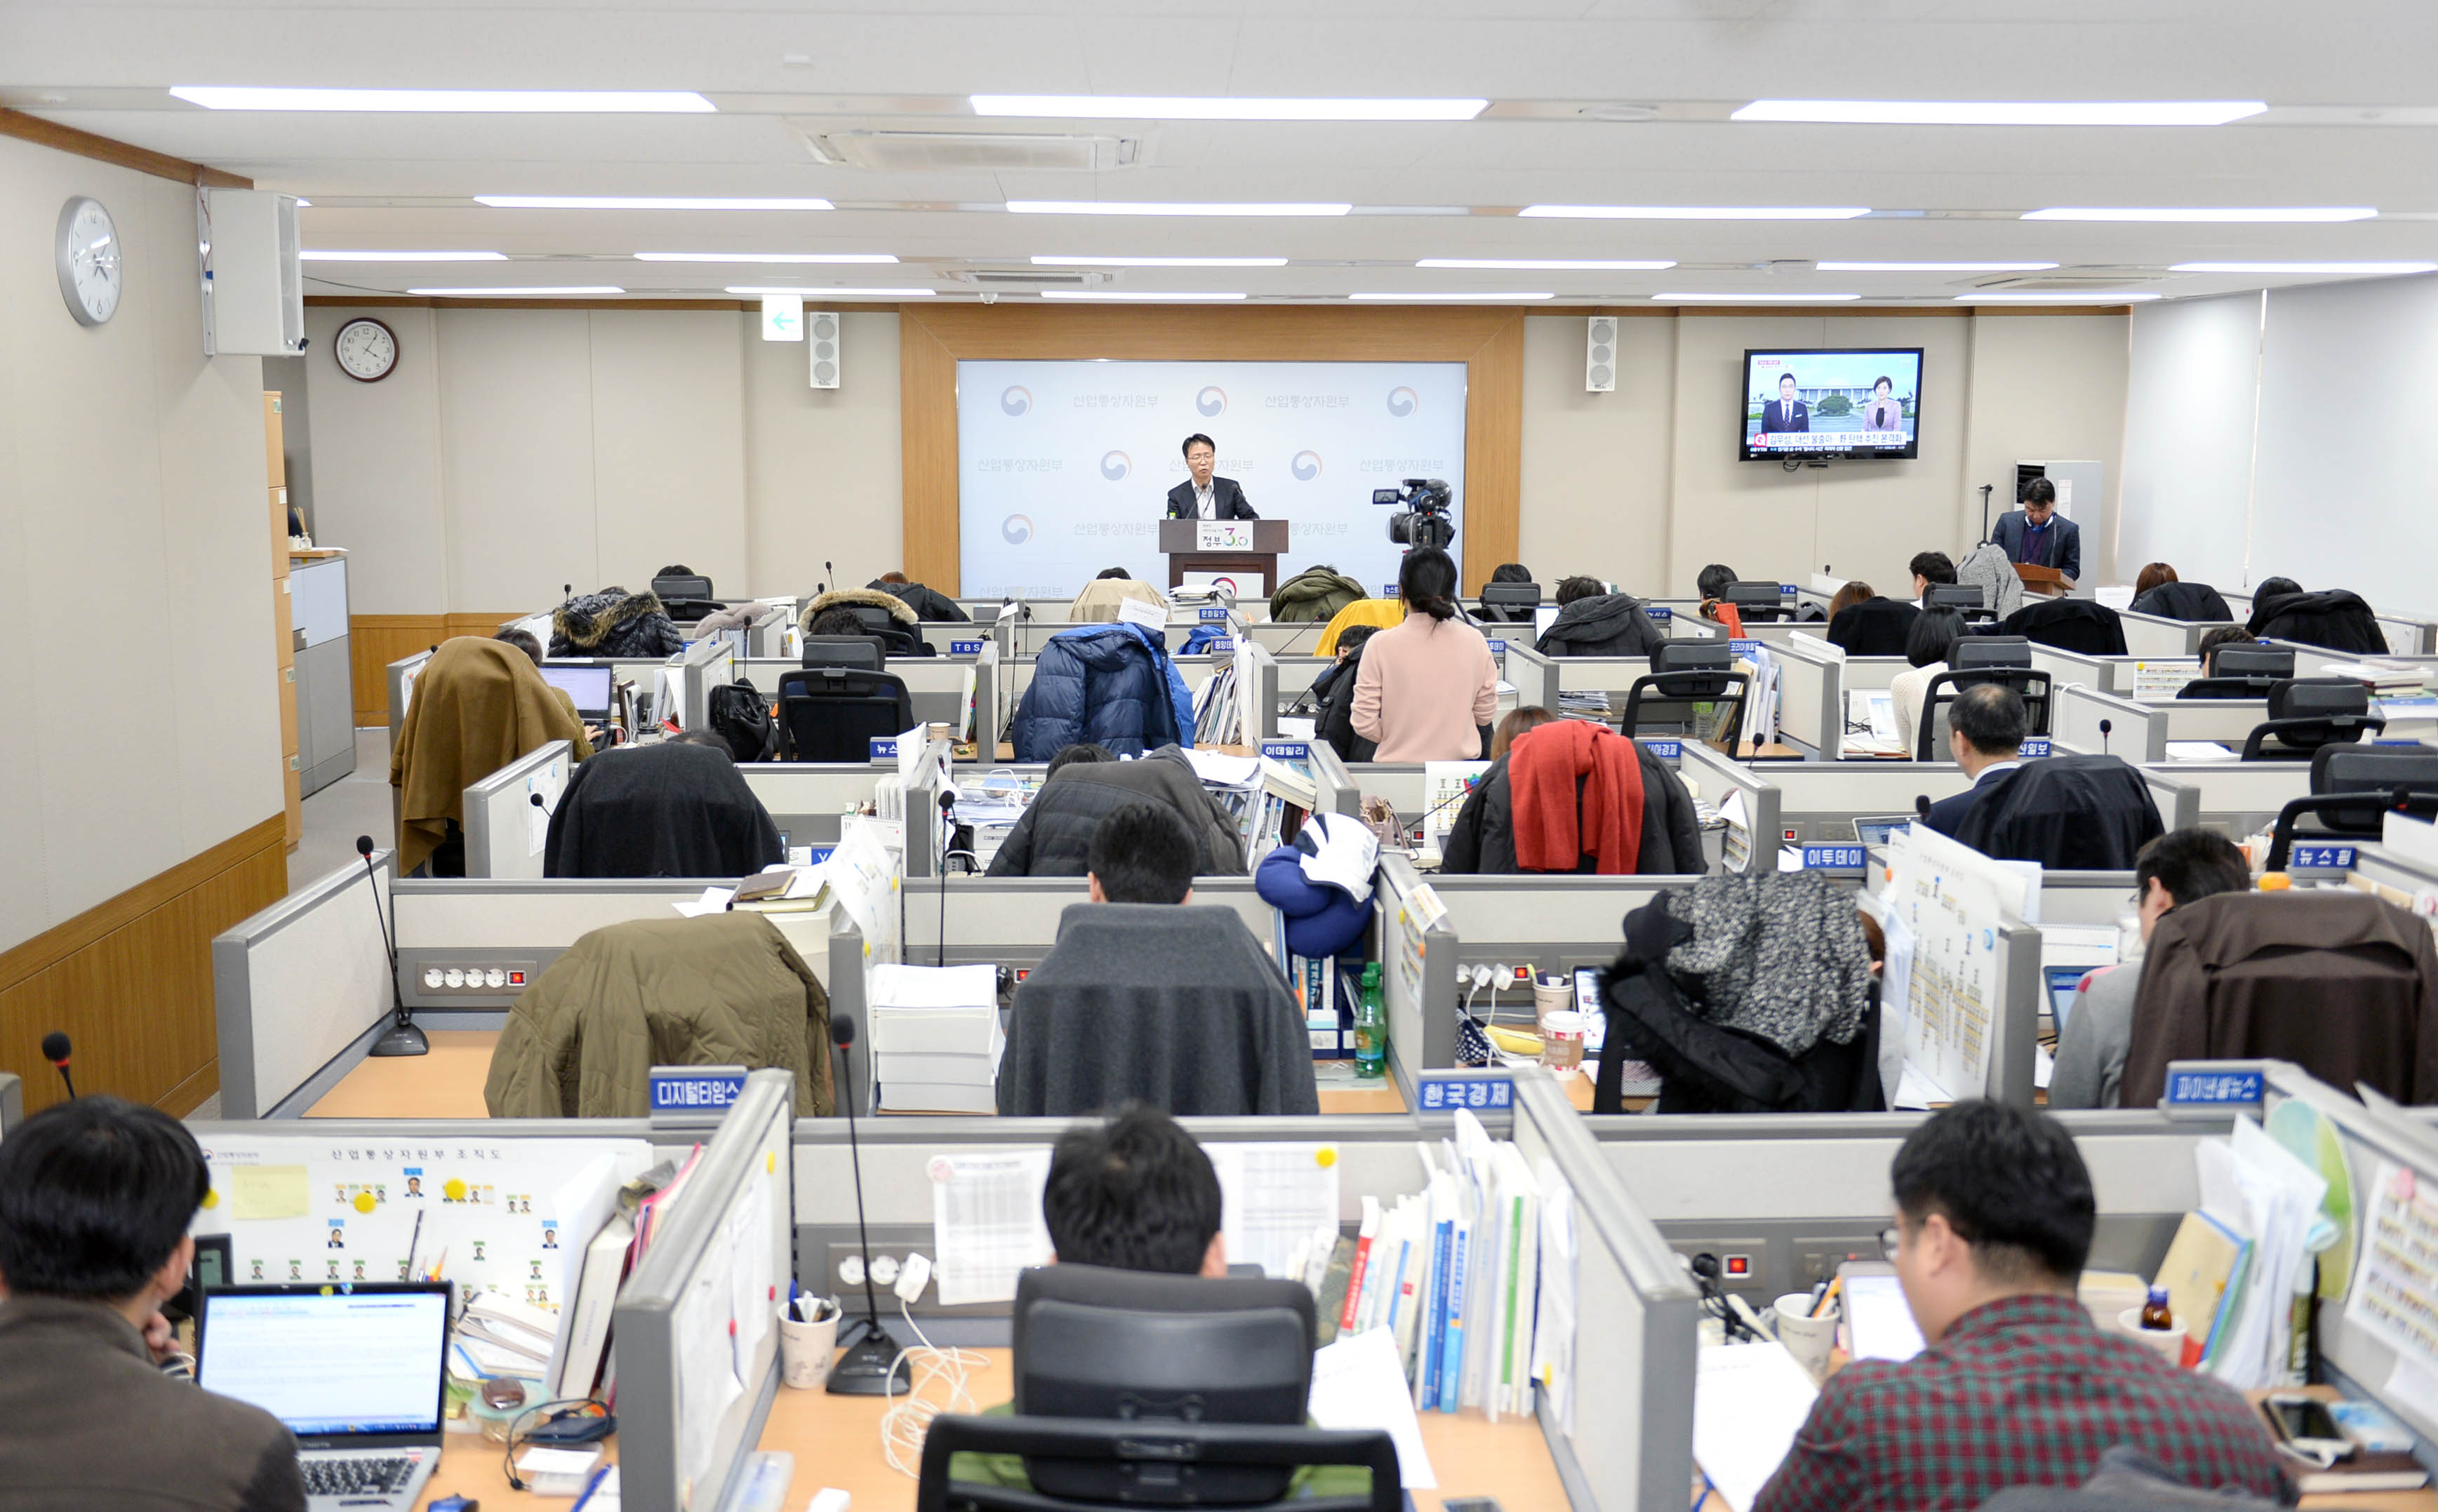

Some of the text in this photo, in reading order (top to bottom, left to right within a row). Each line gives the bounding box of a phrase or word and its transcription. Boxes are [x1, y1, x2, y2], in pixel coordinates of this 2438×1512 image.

[1074, 394, 1159, 410] 산업통상자원부
[1265, 394, 1350, 410] 산업통상자원부
[978, 457, 1063, 473] 산업통상자원부
[1360, 457, 1444, 473] 산업통상자원부
[1074, 521, 1159, 537] 산업통상자원부
[1290, 521, 1348, 537] 통상자원부
[1202, 535, 1223, 548] 정부
[1223, 527, 1248, 547] 3.0
[1201, 610, 1225, 618] 문화일보
[877, 744, 898, 754] 뉴스
[1265, 746, 1305, 756] 이데일리
[1808, 849, 1862, 866] 이투데이
[2299, 849, 2352, 866] 뉴스핌
[657, 1081, 740, 1105] 디지털타임스
[1424, 1083, 1510, 1108] 한국경제
[2176, 1076, 2257, 1100] 파이낸셜뉴스
[331, 1148, 502, 1161] 산업통상자원부 조직도
